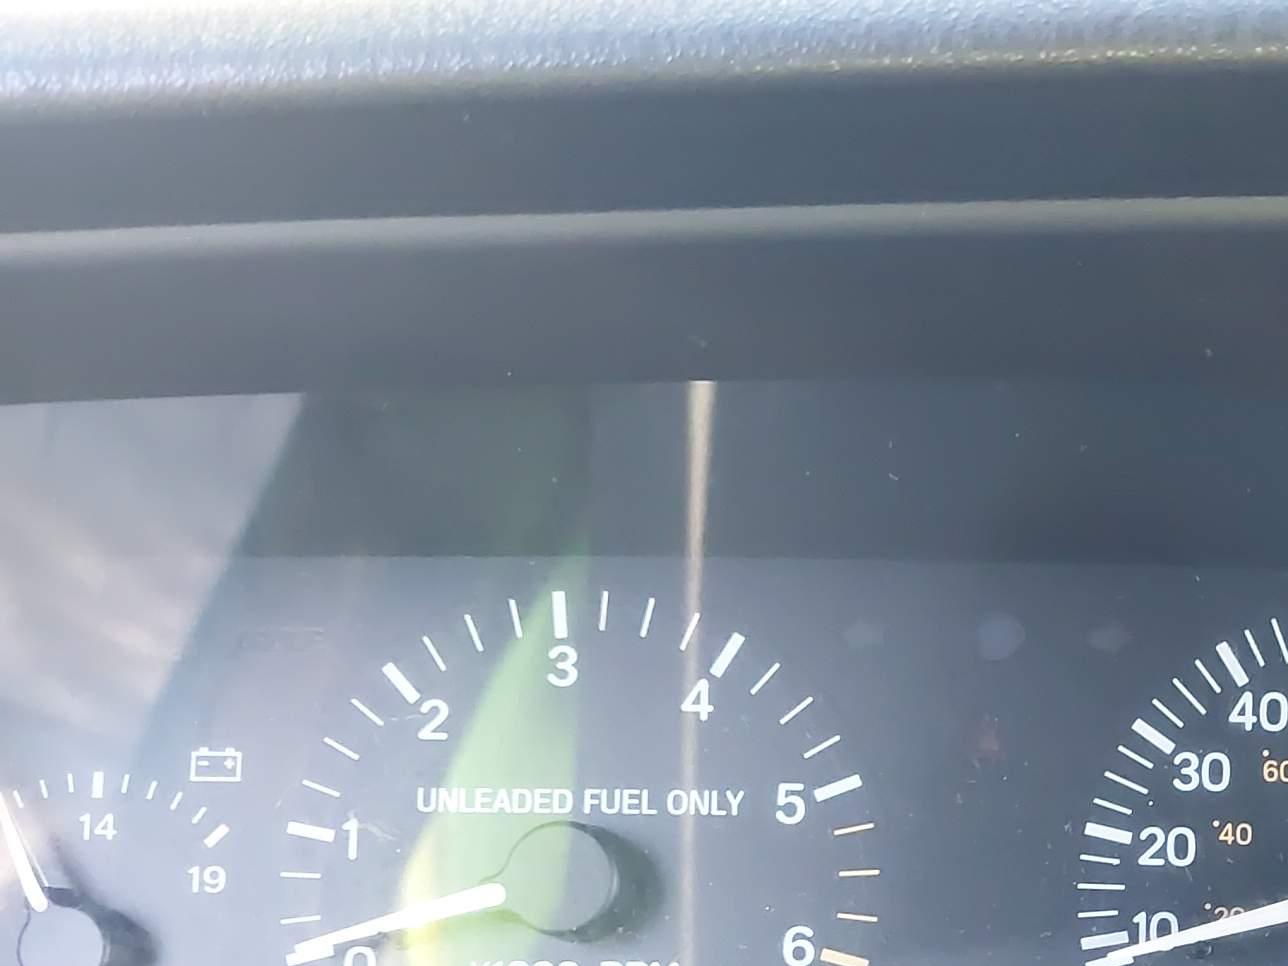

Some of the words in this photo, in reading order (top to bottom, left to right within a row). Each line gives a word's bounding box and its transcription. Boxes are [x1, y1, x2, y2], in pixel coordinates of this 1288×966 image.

[547, 645, 578, 687] 3
[417, 699, 449, 740] 2
[681, 679, 714, 721] 4
[1229, 691, 1288, 731] 40
[1172, 751, 1231, 792] 30
[417, 787, 573, 814] UNLEADED
[582, 789, 657, 814] FUEL
[667, 789, 745, 816] ONLY
[775, 782, 806, 824] 5
[79, 813, 117, 840] 14
[342, 816, 359, 860] 1
[1218, 822, 1253, 845] 40
[1137, 827, 1196, 867] 20
[187, 865, 226, 893] 19
[1132, 911, 1180, 951] 10
